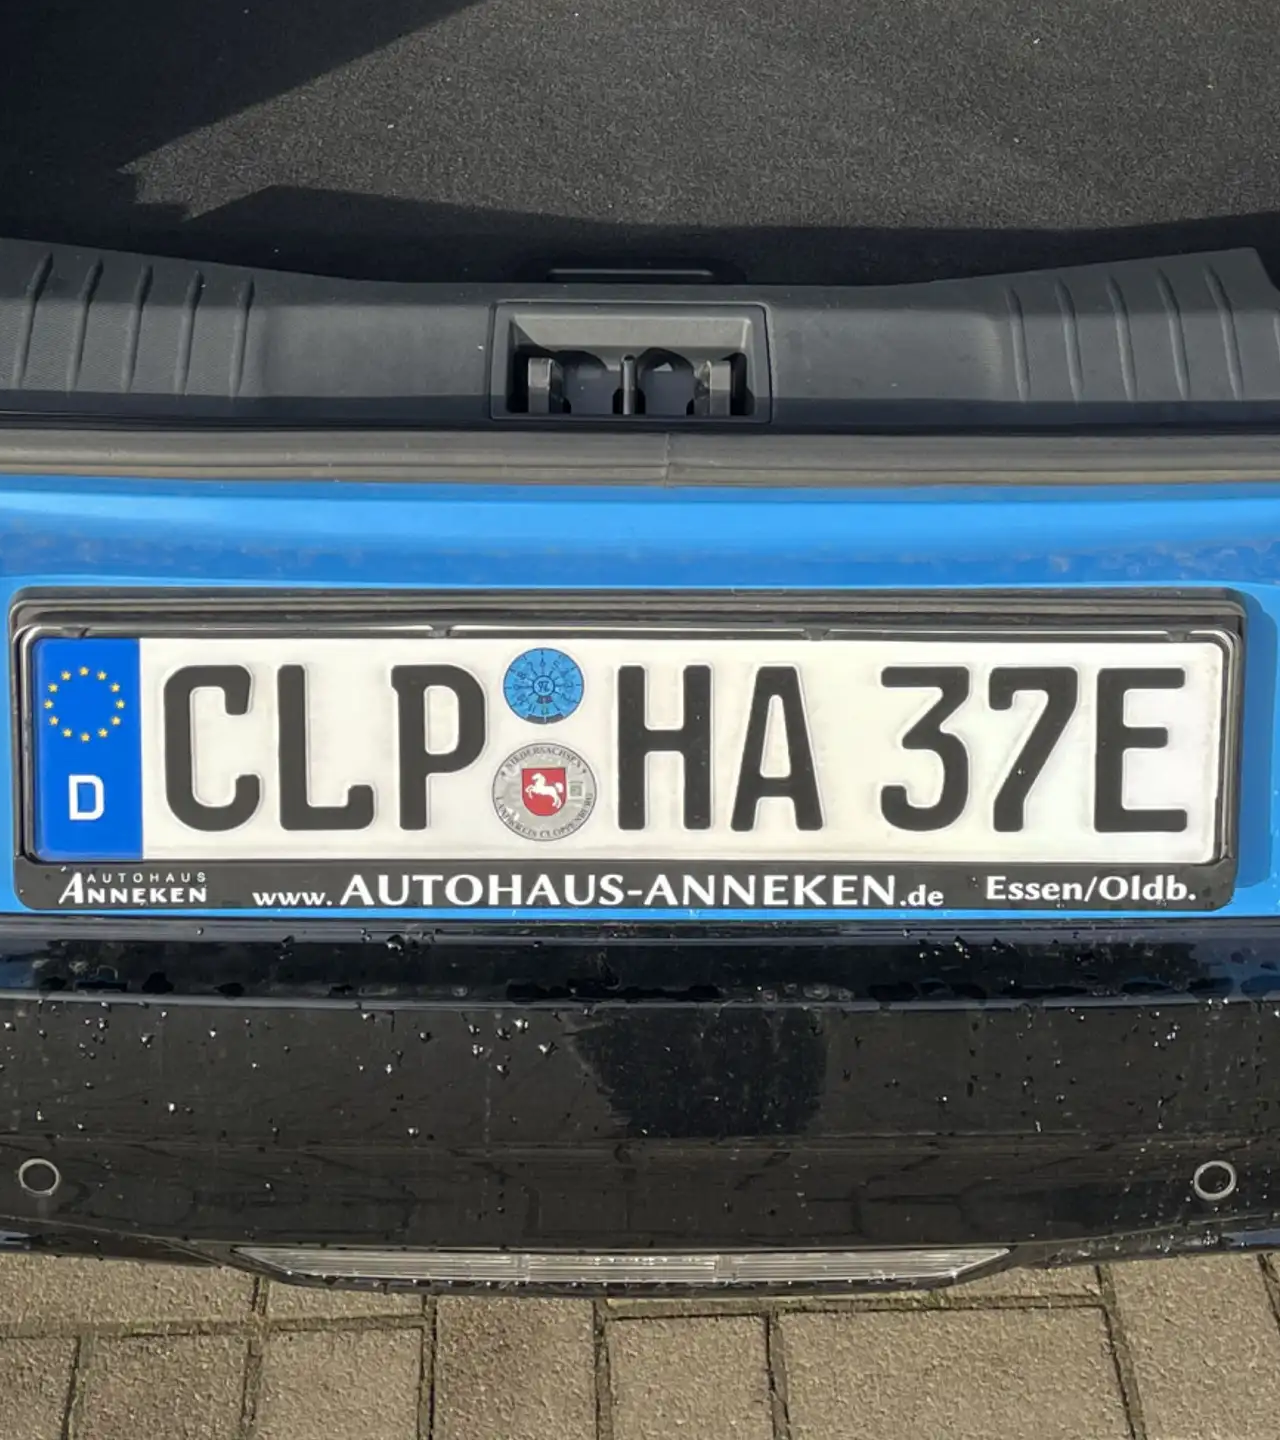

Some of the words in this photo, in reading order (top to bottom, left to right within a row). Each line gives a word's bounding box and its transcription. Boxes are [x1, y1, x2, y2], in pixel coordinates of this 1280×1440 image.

[163, 663, 487, 832] CLP
[617, 663, 824, 833] HA
[880, 665, 1188, 833] 37E
[68, 774, 105, 821] D
[58, 871, 208, 904] ANNEKEN
[86, 871, 207, 883] AUTOHAUS
[986, 874, 1197, 901] Essen/Oldb.
